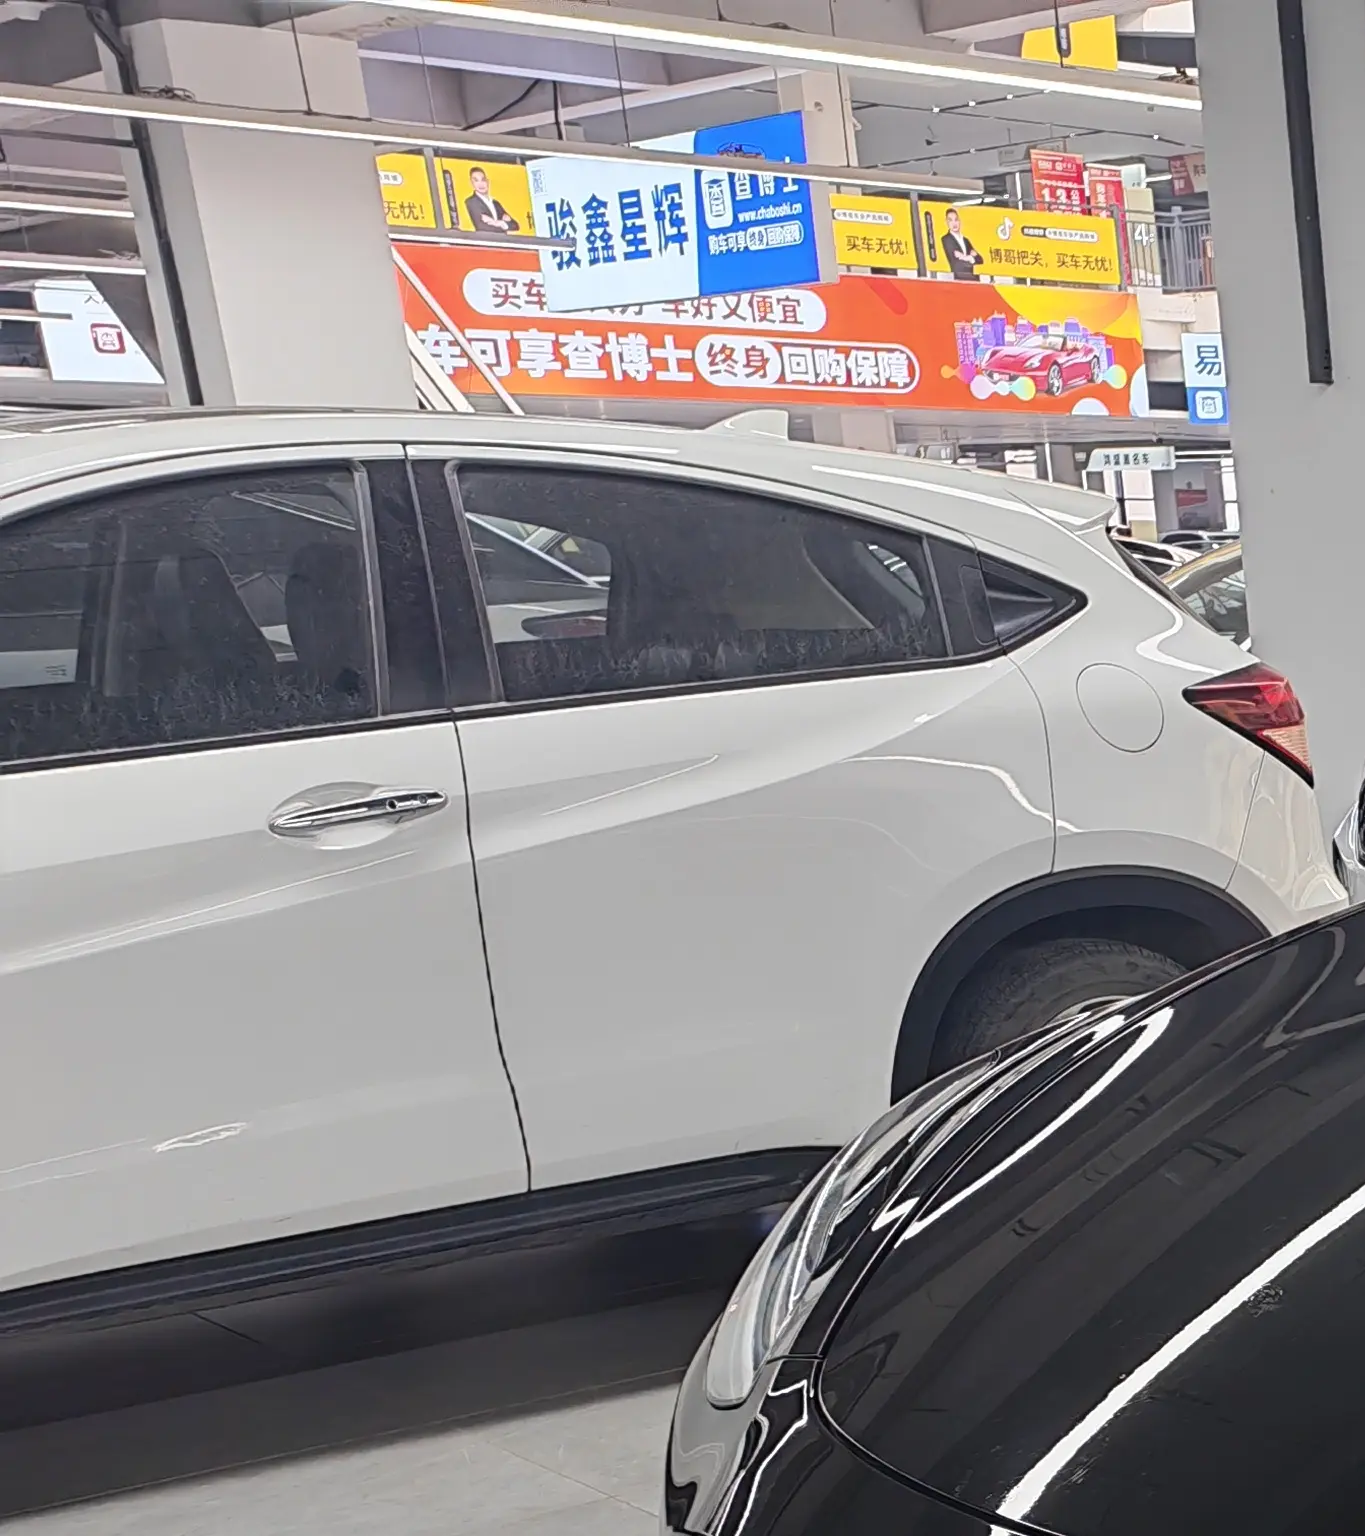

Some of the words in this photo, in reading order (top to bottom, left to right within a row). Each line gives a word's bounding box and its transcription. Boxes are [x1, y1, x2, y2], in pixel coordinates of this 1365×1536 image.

[545, 182, 690, 271] 骏鑫星辉
[737, 202, 803, 223] www.chaboshi.cn
[1194, 345, 1222, 376] 易
